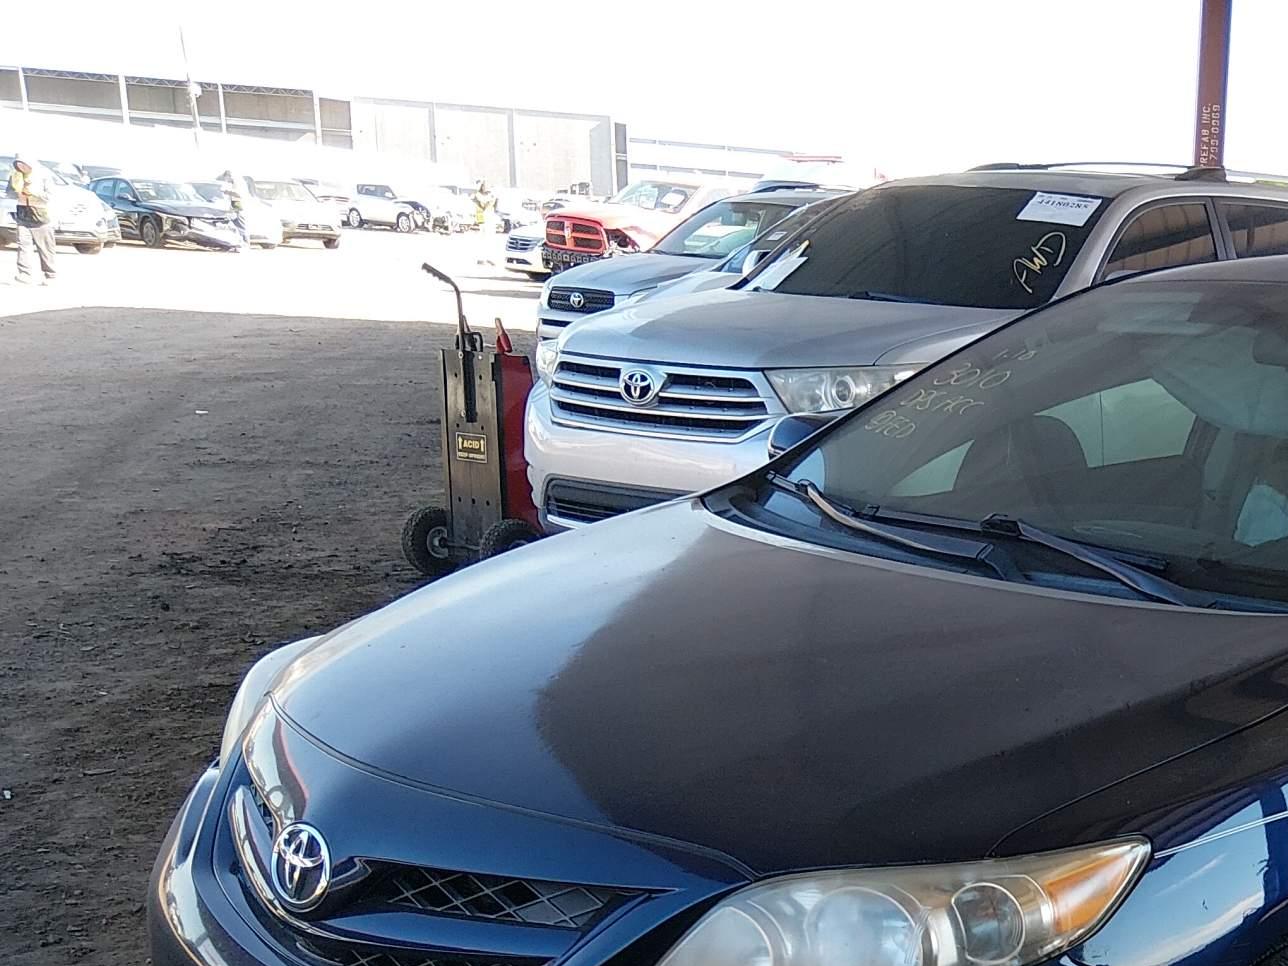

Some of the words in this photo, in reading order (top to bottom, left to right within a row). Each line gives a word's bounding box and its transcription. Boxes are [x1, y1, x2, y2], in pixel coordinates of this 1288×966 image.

[1013, 231, 1066, 294] AWD
[932, 361, 1013, 390] 3010
[463, 439, 480, 449] ACID
